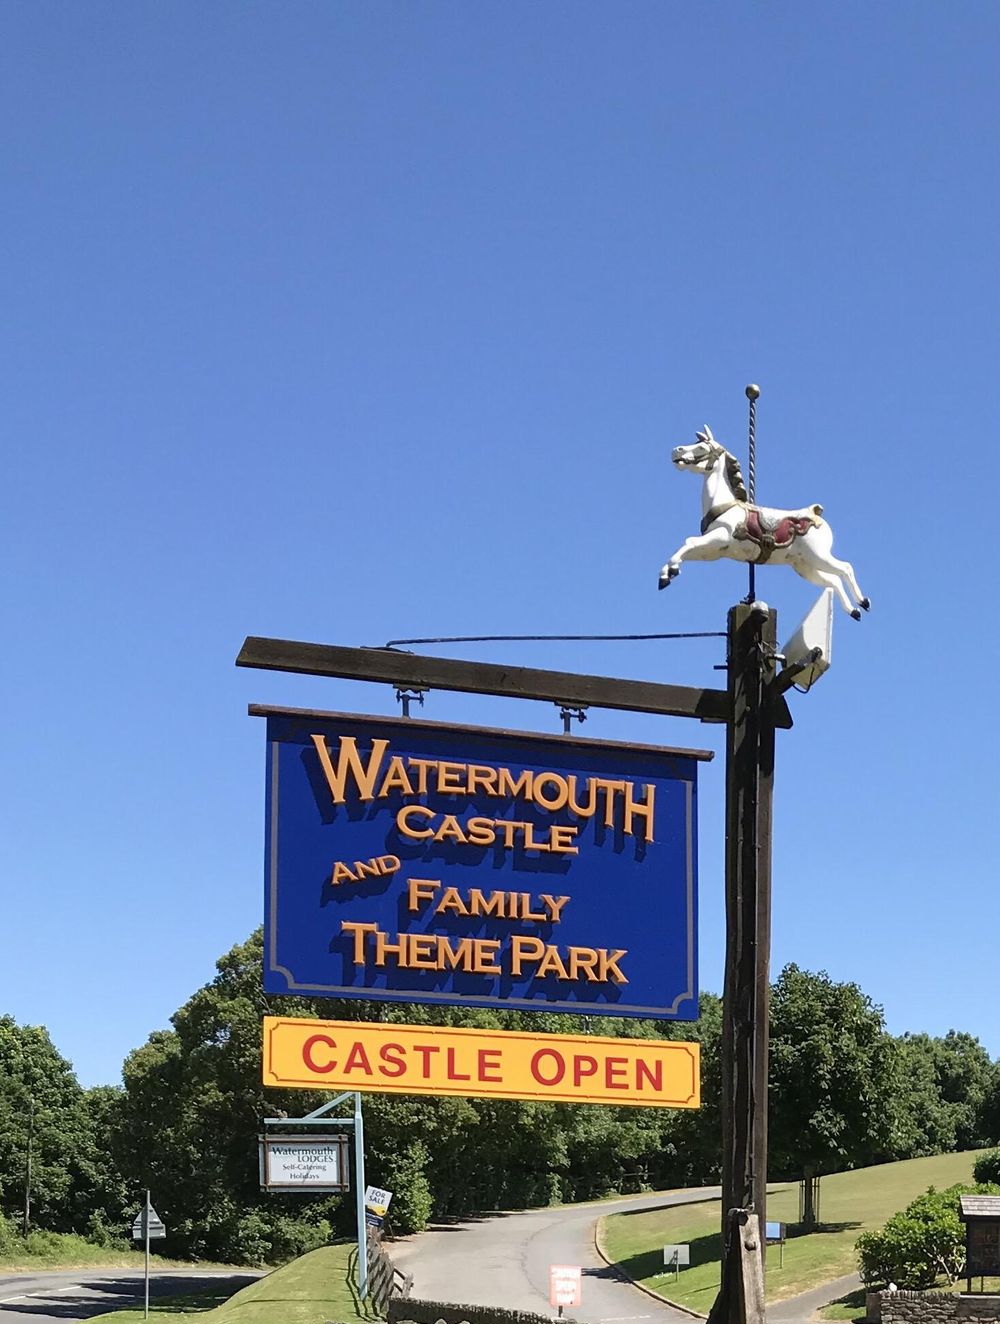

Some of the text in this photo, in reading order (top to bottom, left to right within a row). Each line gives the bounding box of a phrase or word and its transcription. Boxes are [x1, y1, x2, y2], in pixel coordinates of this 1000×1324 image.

[310, 734, 656, 843] WATERMOUTH
[396, 805, 579, 855] CASTLE
[331, 854, 401, 885] AND
[407, 878, 571, 923] FAMILY
[341, 920, 630, 984] THEME PARK
[302, 1034, 663, 1092] CASTLE OPEN
[272, 1146, 334, 1156] Watermouth
[297, 1155, 334, 1163] LODGES
[371, 1189, 386, 1199] FOR
